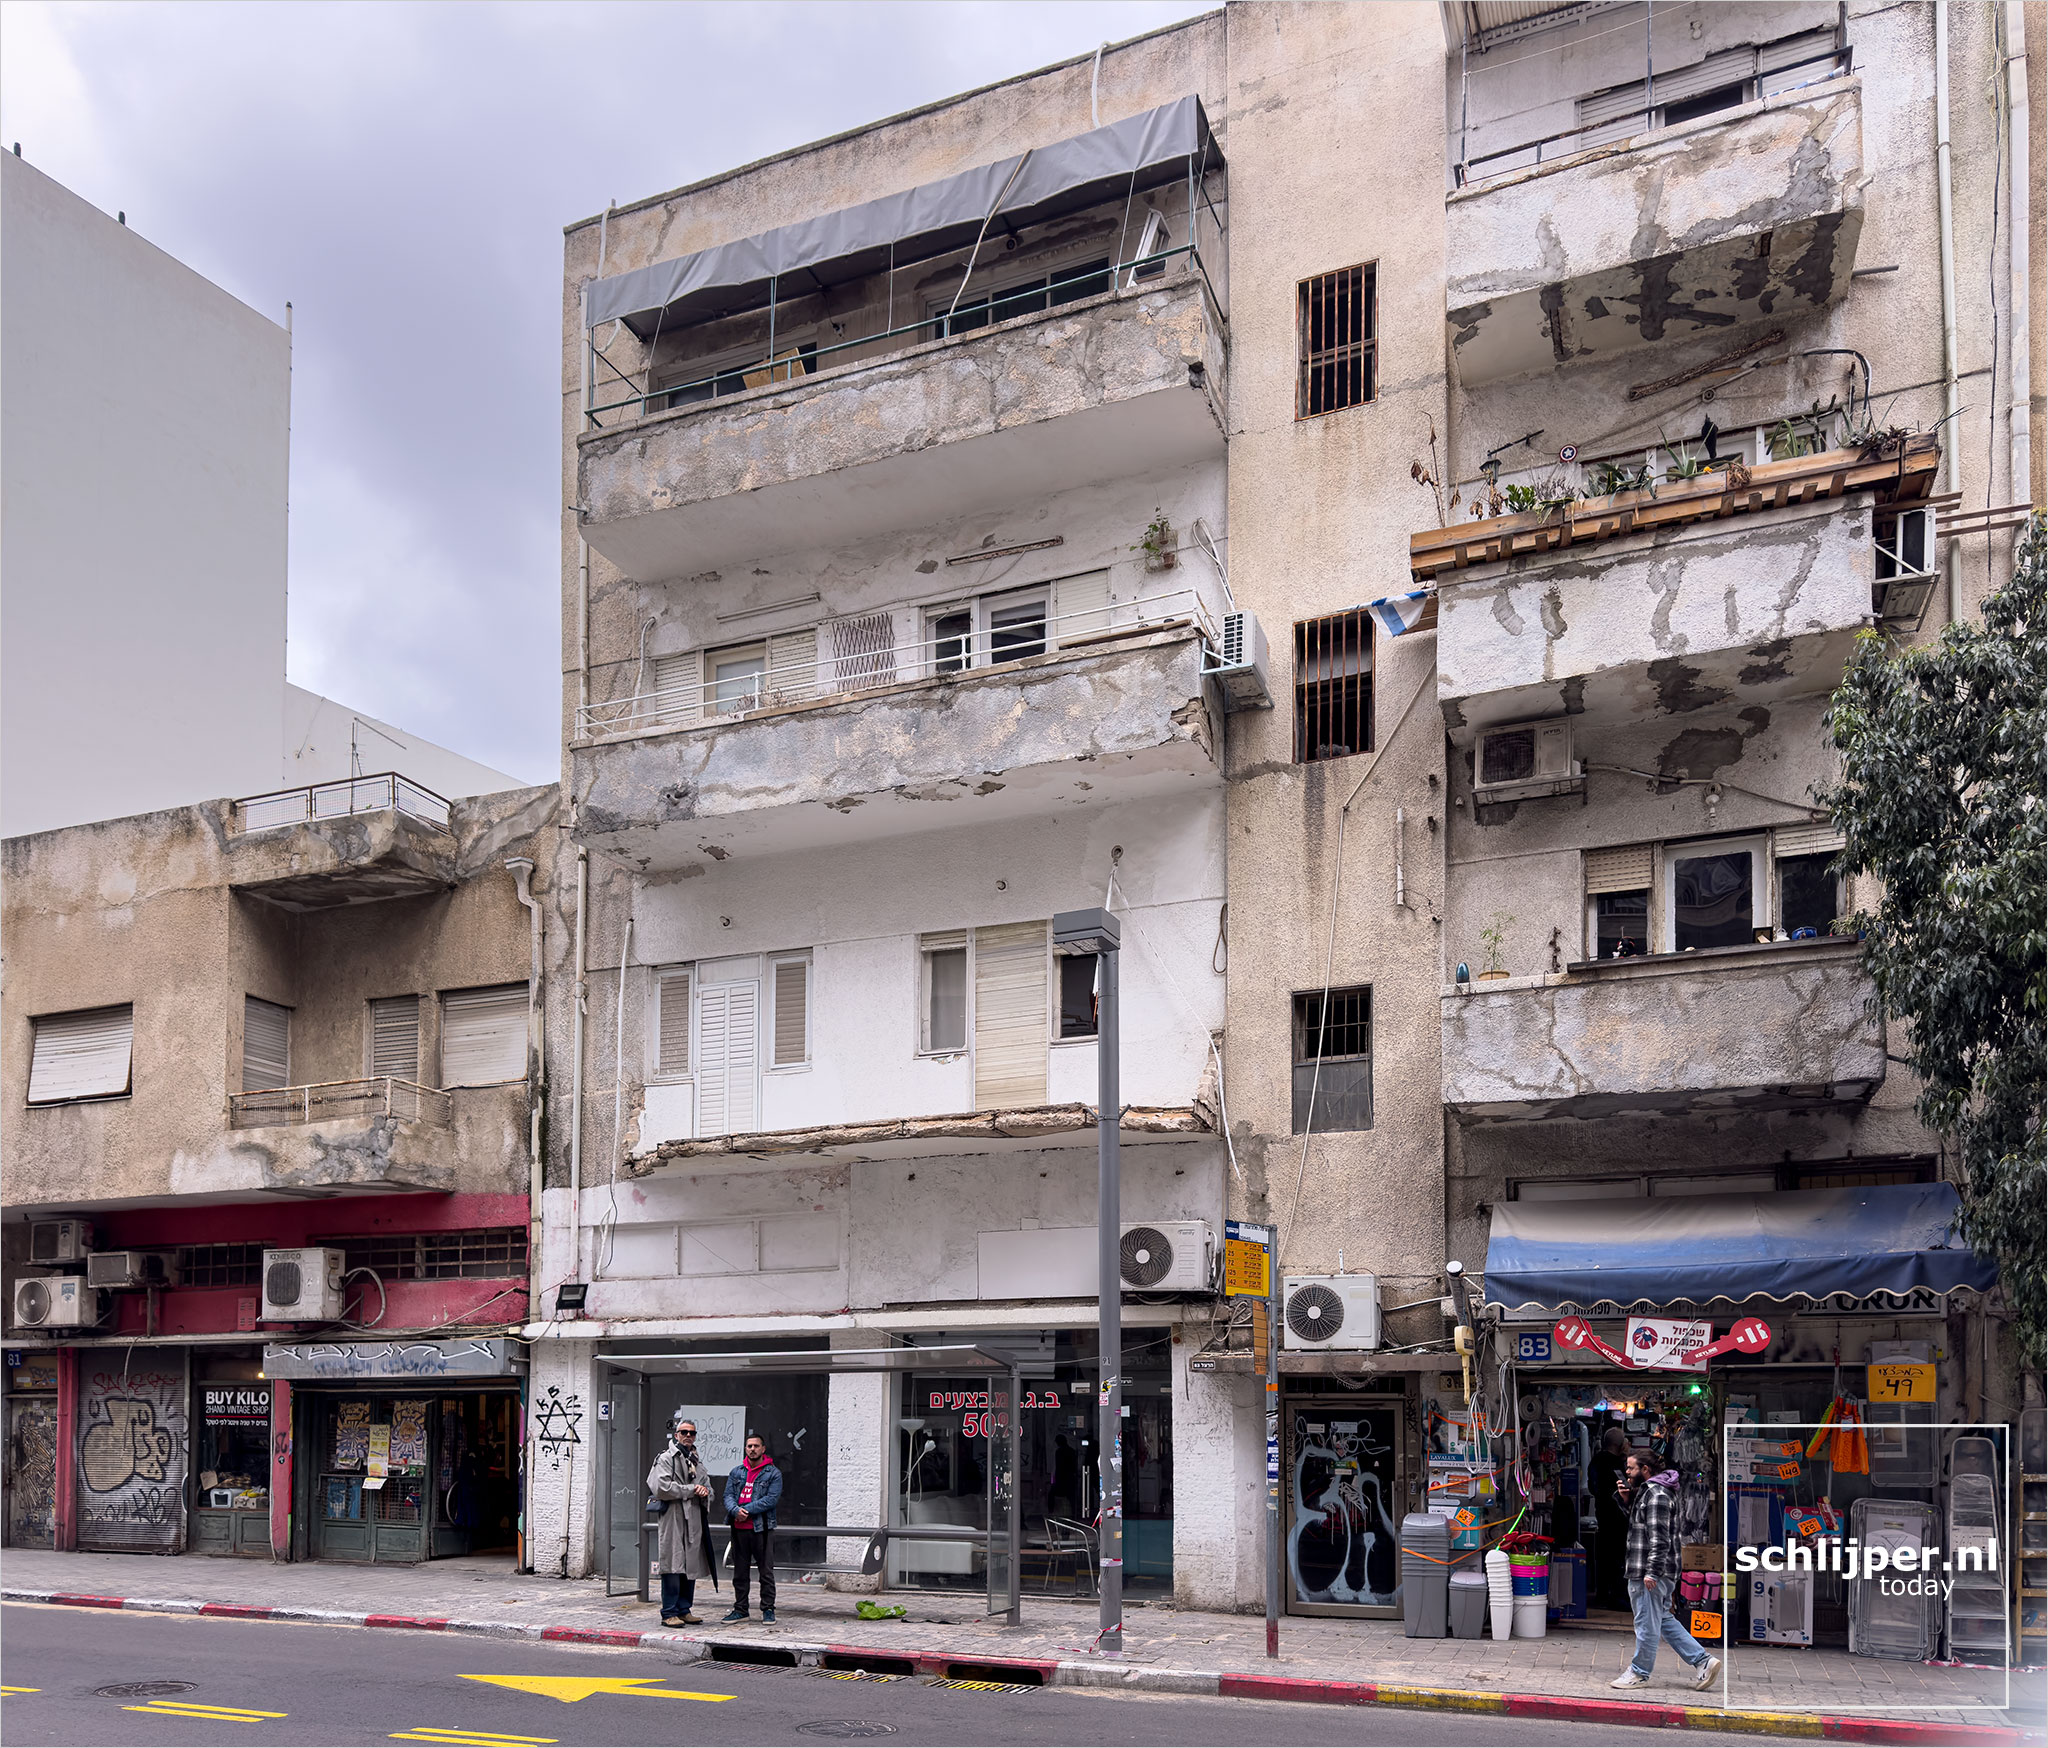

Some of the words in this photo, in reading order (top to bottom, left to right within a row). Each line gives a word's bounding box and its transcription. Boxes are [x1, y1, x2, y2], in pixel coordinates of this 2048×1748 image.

[1519, 1338, 1549, 1357] 83
[1695, 1346, 1718, 1359] KEYLINE
[8, 1353, 21, 1366] 81
[1886, 1379, 1913, 1396] 49
[205, 1391, 234, 1405] BUY
[236, 1391, 270, 1406] KILO
[205, 1405, 226, 1414] 2HAND
[227, 1405, 251, 1415] VINTAGE
[252, 1405, 269, 1415] SHOP
[1754, 1581, 1765, 1594] 9
[1693, 1619, 1711, 1632] 50
